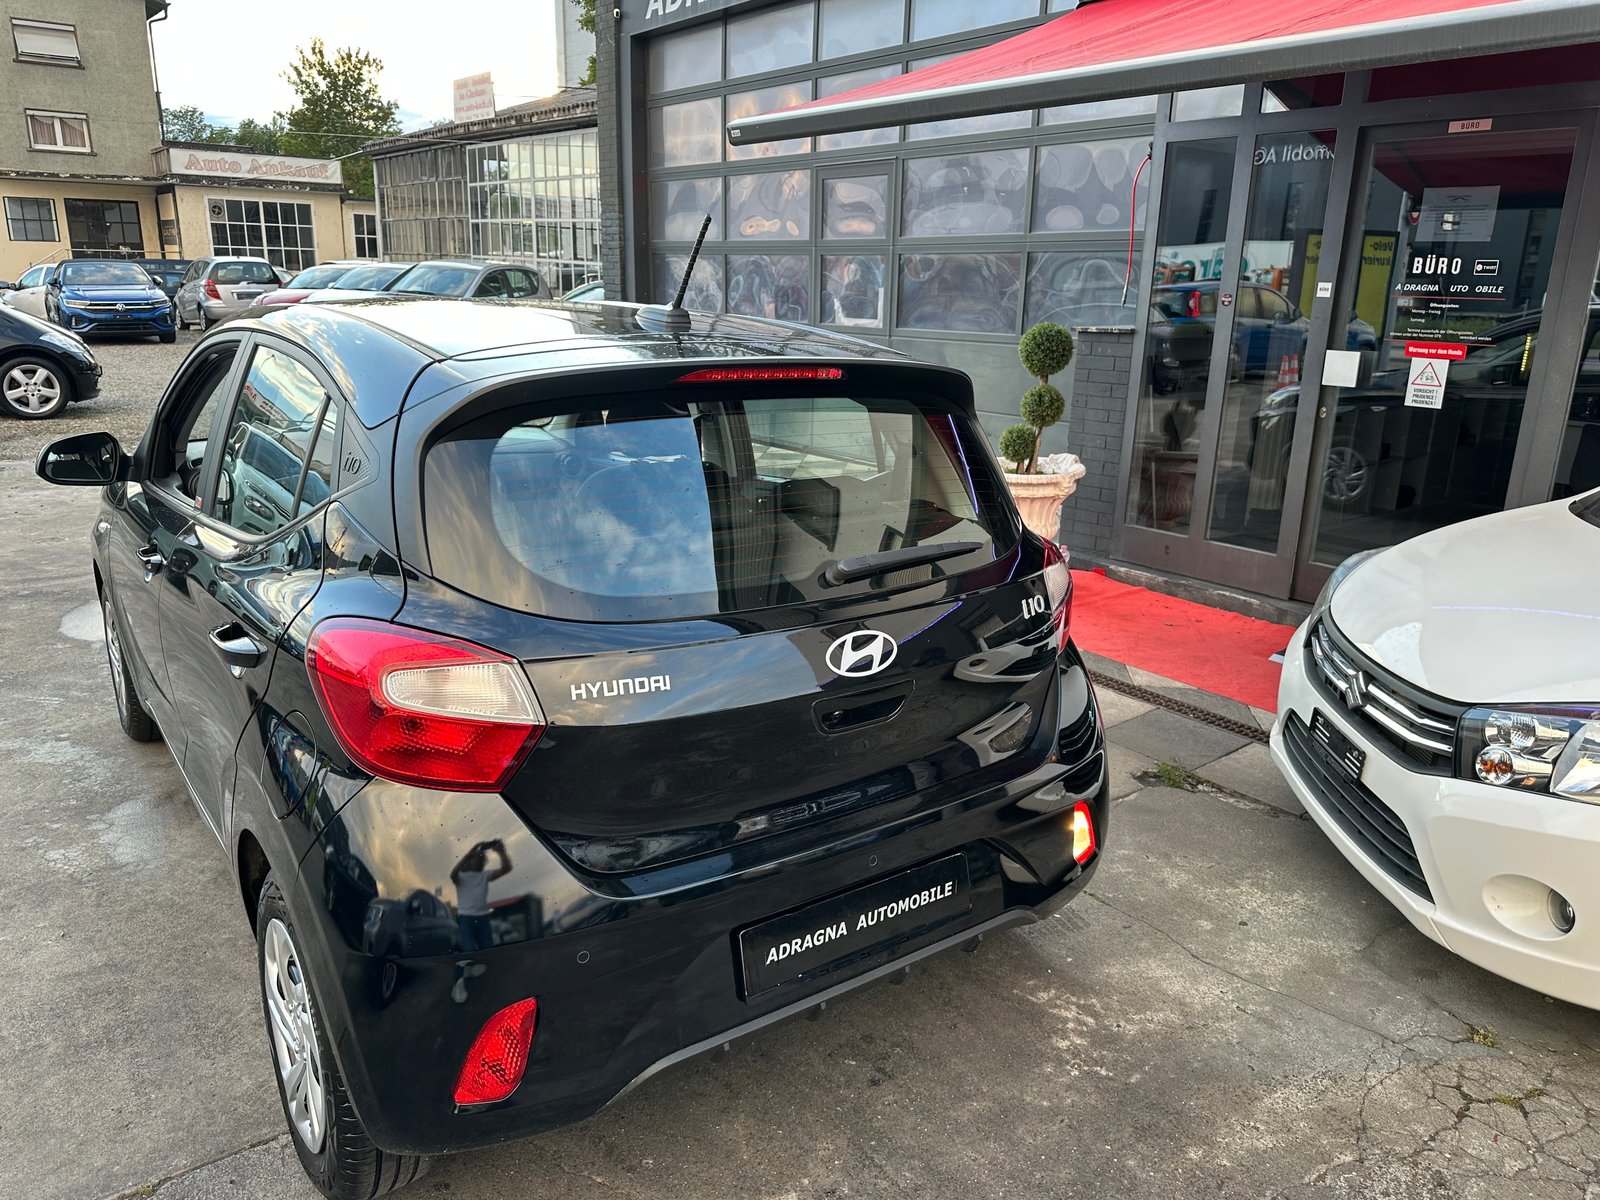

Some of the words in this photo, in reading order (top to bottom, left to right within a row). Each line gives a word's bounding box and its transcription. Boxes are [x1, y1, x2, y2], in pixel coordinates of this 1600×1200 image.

[645, 0, 704, 20] AD
[1460, 121, 1480, 130] BÜRO
[185, 153, 242, 174] Auto
[247, 158, 329, 180] Ankauf
[1412, 254, 1462, 275] BÜRO
[1408, 346, 1429, 354] Warnung
[342, 451, 361, 475] i10
[570, 675, 671, 701] HYUNDAI
[765, 921, 848, 965] ADRAGNA
[856, 881, 953, 931] AUTOMOBILE
